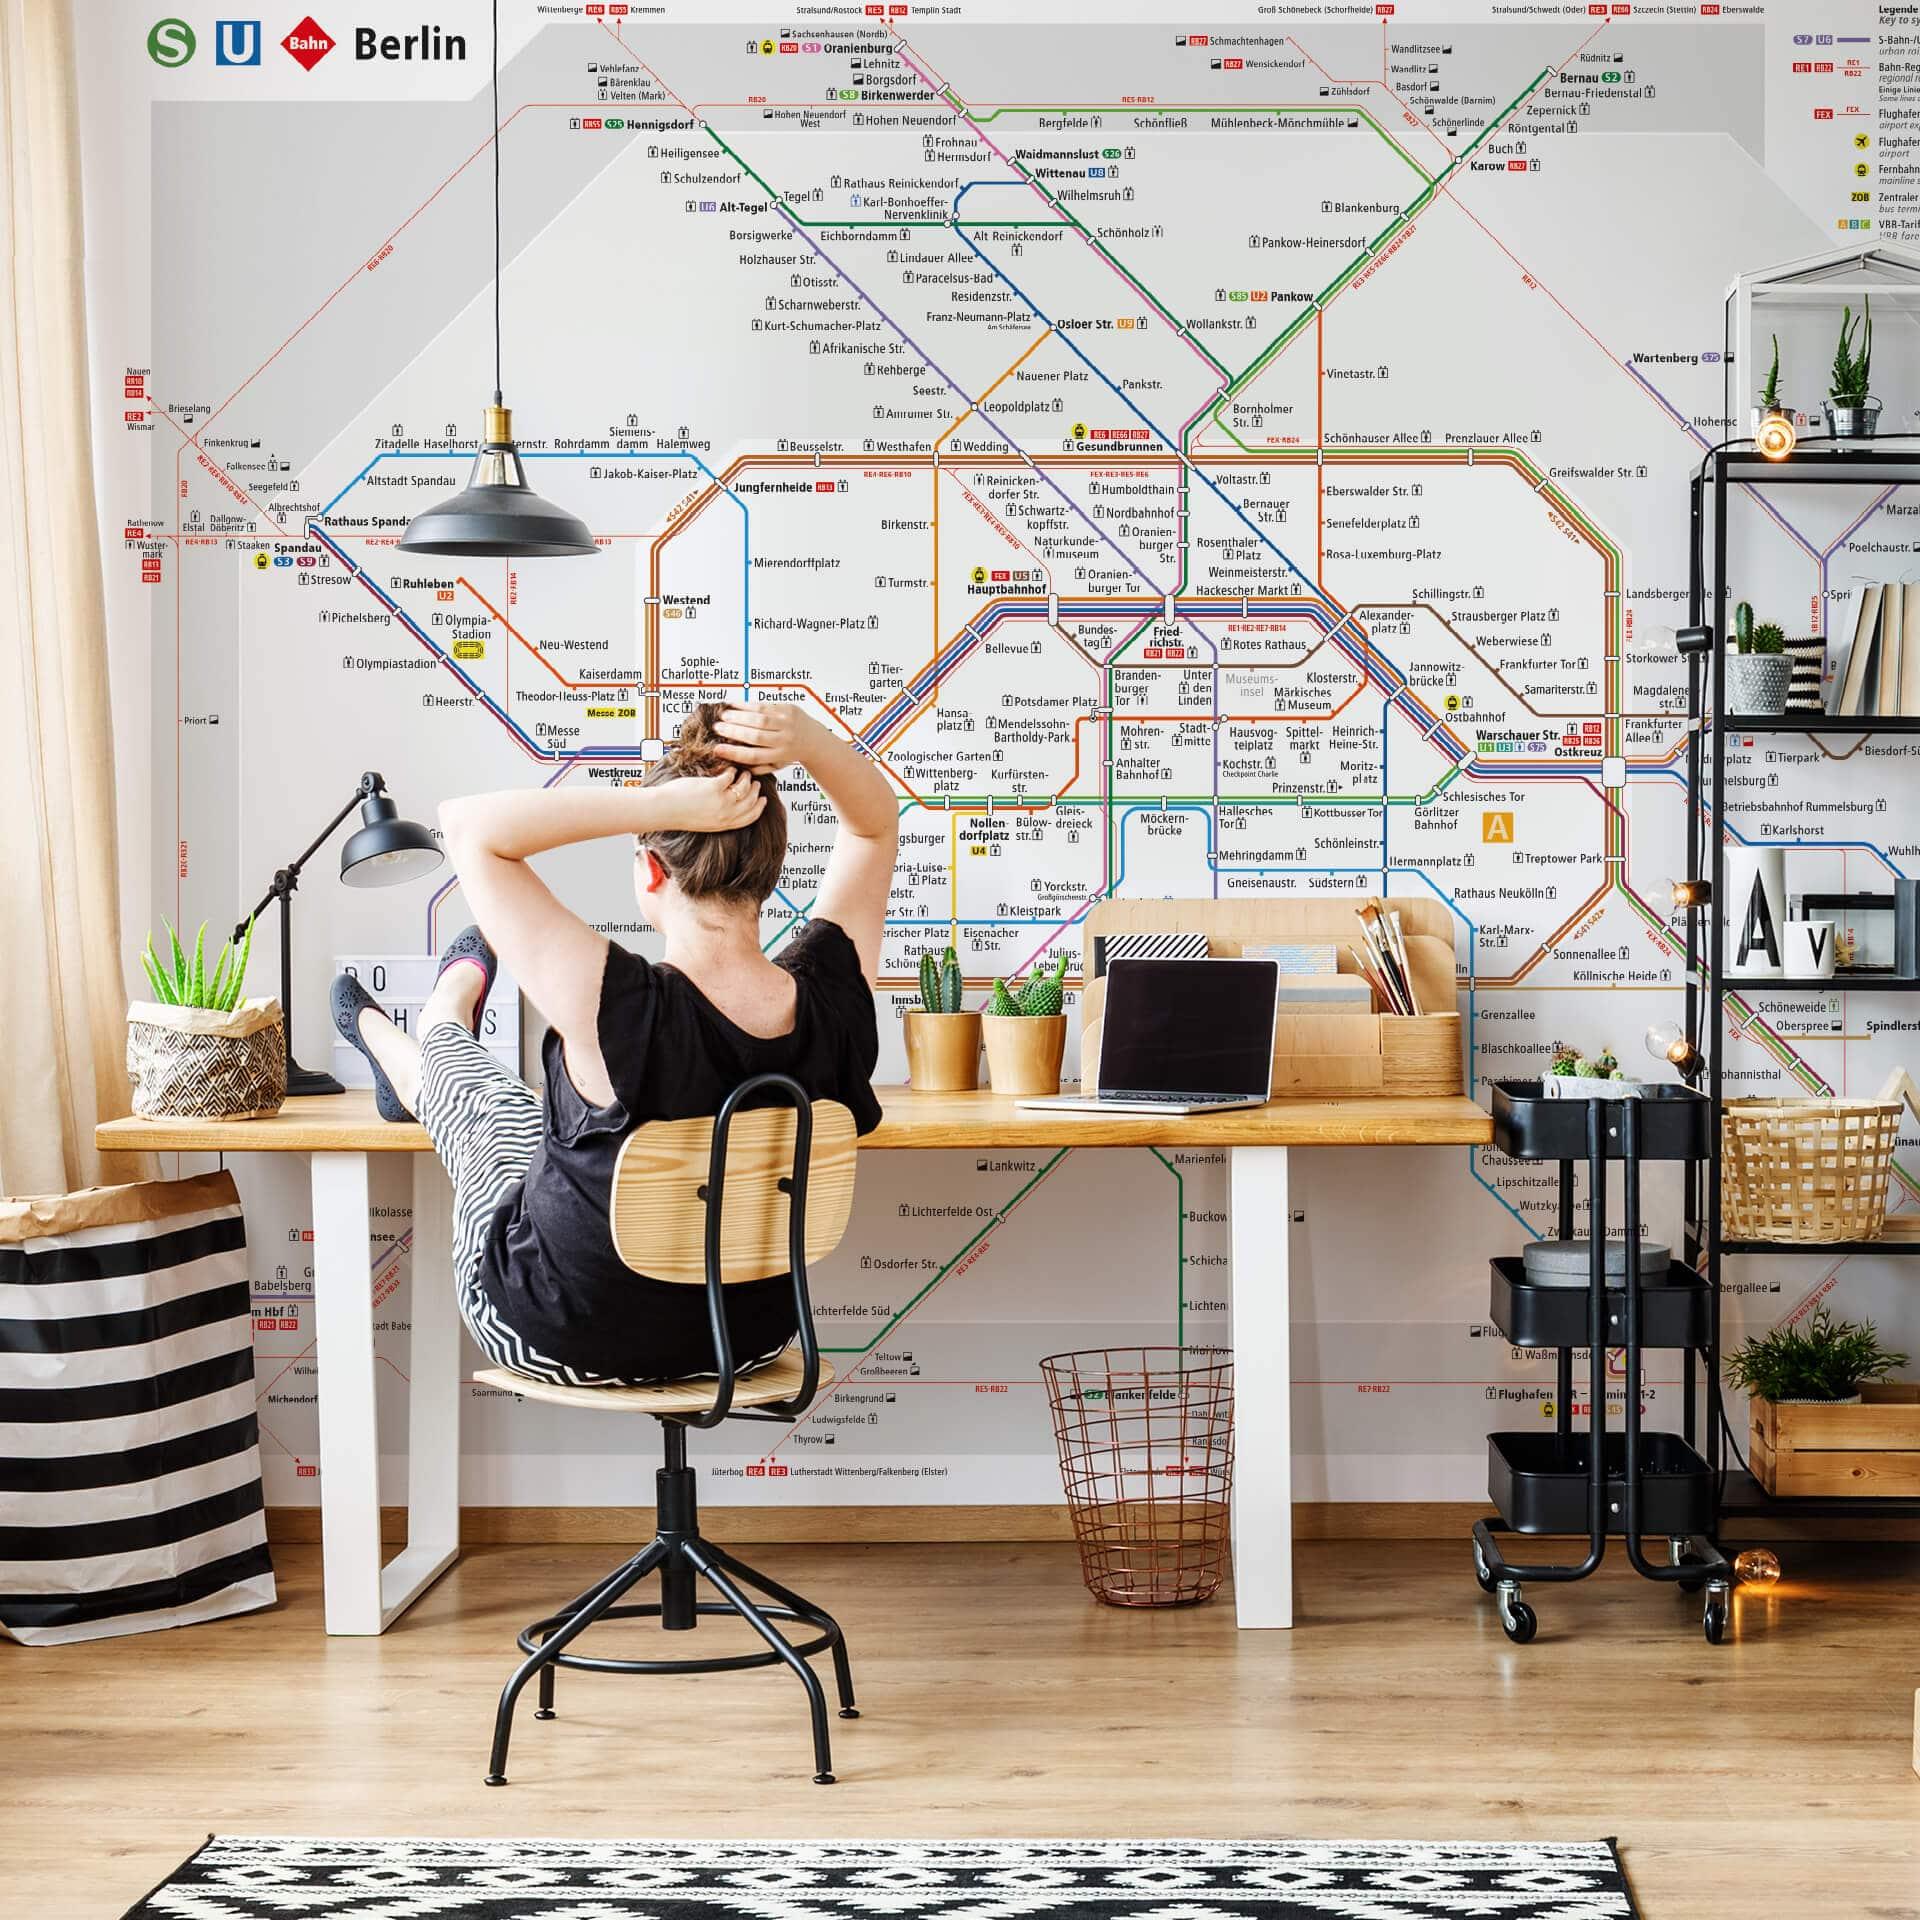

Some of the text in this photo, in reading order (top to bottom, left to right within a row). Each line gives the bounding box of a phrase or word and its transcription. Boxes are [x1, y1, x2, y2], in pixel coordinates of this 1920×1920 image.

[1879, 5, 1918, 17] Legende
[289, 36, 328, 51] Bahn
[356, 25, 466, 60] Berlin
[824, 43, 893, 55] Oranienburg
[863, 58, 900, 69] Lehnitz
[866, 74, 917, 88] Borgsdorf
[1560, 73, 1599, 83] Bernau
[861, 90, 935, 101] Birkenwerder
[1545, 87, 1642, 98] Bernau-Friedenstal
[1526, 105, 1577, 118] Zepernick
[1508, 122, 1565, 136] Röntgental
[661, 147, 720, 161] Heiligensee
[1488, 143, 1513, 154] Buch
[1879, 148, 1910, 159] airport
[1015, 149, 1099, 160] Waidmannslust
[1471, 161, 1505, 171] Karow
[674, 173, 741, 184] Schulzendorf
[1035, 168, 1085, 178] Wittenau
[783, 190, 810, 203] Tegel
[1057, 189, 1121, 202] Wilhelmsruh
[1851, 193, 1869, 202] ZOB
[1878, 192, 1919, 202] Zentraler
[719, 202, 767, 215] Alt-Tegel
[1335, 202, 1399, 216] Blankenburg
[729, 230, 793, 243] Borsigwerke
[821, 230, 897, 241] Eichborndamm
[1097, 227, 1150, 238] Schönholz
[1262, 237, 1367, 249] Pankow-Heinersdorf
[740, 254, 817, 265] Holzhauser Str.
[803, 277, 838, 287] Otisstr.
[1271, 291, 1313, 302] Pankow
[778, 300, 861, 310] Scharnweberstr.
[927, 311, 1031, 322] Franz-Neumann-Platz
[765, 321, 881, 331] Kurt-Schumacher-Platz
[1057, 319, 1093, 331] Osloer
[1096, 320, 1114, 329] Str.
[1186, 319, 1243, 331] Wollankstr.
[1633, 352, 1698, 366] Wartenberg
[1017, 370, 1088, 381] Nauener Platz
[1326, 368, 1375, 379] Vinetastr.
[1123, 379, 1163, 389] Pankstr.
[168, 403, 211, 415] Brieselang
[984, 400, 1050, 414] Leopoldplatz
[204, 438, 249, 448] Finkenkrug
[1324, 432, 1418, 443] Schönhauser Allee
[1445, 432, 1528, 443] Prenzlauer Allee
[375, 438, 420, 449] Zitadelle
[554, 438, 610, 449] Rohrdamm
[657, 437, 710, 452] Halemweg
[876, 441, 932, 452] Westhafen
[963, 441, 1009, 455] Wedding
[1076, 441, 1163, 451] Gesundbrunnen
[603, 467, 699, 479] Jakob-Kaiser-Platz
[1549, 467, 1634, 478] Greifswalder Str.
[367, 475, 456, 488] Altstadt Spandau
[734, 482, 812, 494] Jungfernheide
[1102, 484, 1174, 495] Humboldthain
[1327, 486, 1408, 496] Eberswalder Str.
[268, 502, 321, 512] Albrechtshof
[1106, 507, 1174, 519] Nordbahnhof
[324, 516, 369, 526] Rathaus
[881, 519, 929, 530] Birkenstr.
[274, 543, 322, 555] Spandau
[1849, 541, 1911, 552] Poelchaustr.
[754, 557, 841, 571] Mierendorffplatz
[311, 575, 352, 585] Stresow
[403, 578, 454, 589] Ruhleben
[968, 584, 1047, 596] Hauptbahnhof
[1412, 588, 1471, 601] Schillingstr.
[662, 595, 710, 605] Westend
[332, 611, 392, 626] Pichelsberg
[1451, 611, 1546, 624] Strausberger Platz
[754, 618, 865, 631] Richard-Wagner-Platz
[540, 640, 608, 650] Neu-Westend
[1476, 635, 1539, 646] Weberwiese
[356, 657, 437, 671] Olympiastadion
[1500, 659, 1576, 669] Frankfurter Tor
[579, 668, 642, 680] Kaiserdamm
[751, 668, 812, 680] Bismarckstr.
[1307, 672, 1358, 684] Klosterstr.
[1524, 684, 1585, 695] Samariterstr.
[587, 709, 636, 717] Messe ZOB
[1445, 711, 1506, 723] Ostbahnhof
[548, 725, 580, 736] Messe
[1476, 729, 1560, 742] Warschauer Str.
[547, 738, 566, 749] Süd
[1554, 747, 1603, 757] Ostkreuz
[1223, 758, 1263, 769] Kochstr.
[1777, 752, 1820, 765] Tierpark
[588, 767, 642, 778] Westkreuz
[1222, 770, 1279, 778] Checkpoint Charlie
[1443, 791, 1525, 802] Schlesisches Tor
[1314, 808, 1383, 818] Kottbusser Tor
[1806, 801, 1873, 815] Rummelsburg
[970, 817, 1008, 828] Nollen-
[1772, 825, 1824, 835] Karlshorst
[959, 830, 1009, 843] dorfplatz
[1314, 837, 1380, 849] Schönleinstr.
[1219, 850, 1294, 863] Mehringdamm
[1525, 853, 1602, 866] Treptower Park
[1044, 881, 1087, 892] Yorckstr.
[1227, 878, 1296, 888] Gneisenaustr.
[1454, 887, 1544, 899] Rathaus Neukölln
[1010, 905, 1061, 920] Kleistpark
[1735, 868, 1781, 967] A
[1807, 927, 1828, 969] V
[1553, 948, 1616, 960] Sonnenallee
[1758, 1000, 1826, 1014] Schöneweide
[1480, 1010, 1535, 1020] Grenzallee
[1776, 1019, 1829, 1033] Oberspree
[1481, 1043, 1551, 1055] Blaschkoallee
[989, 1160, 1035, 1172] Lankwitz
[912, 1206, 993, 1217] Lichterfelde Ost
[873, 1258, 938, 1269] Osdorfer Str.
[254, 1280, 311, 1292] Babelsberg
[834, 1393, 884, 1404] Birkengrund
[1499, 1388, 1553, 1403] Flughafen
[812, 1415, 866, 1426] Ludwigsfelde
[790, 1467, 833, 1476] Lutherstadt
[834, 1467, 919, 1477] Wittenberg/Falkenberg
[921, 1467, 948, 1476] (Elster)
